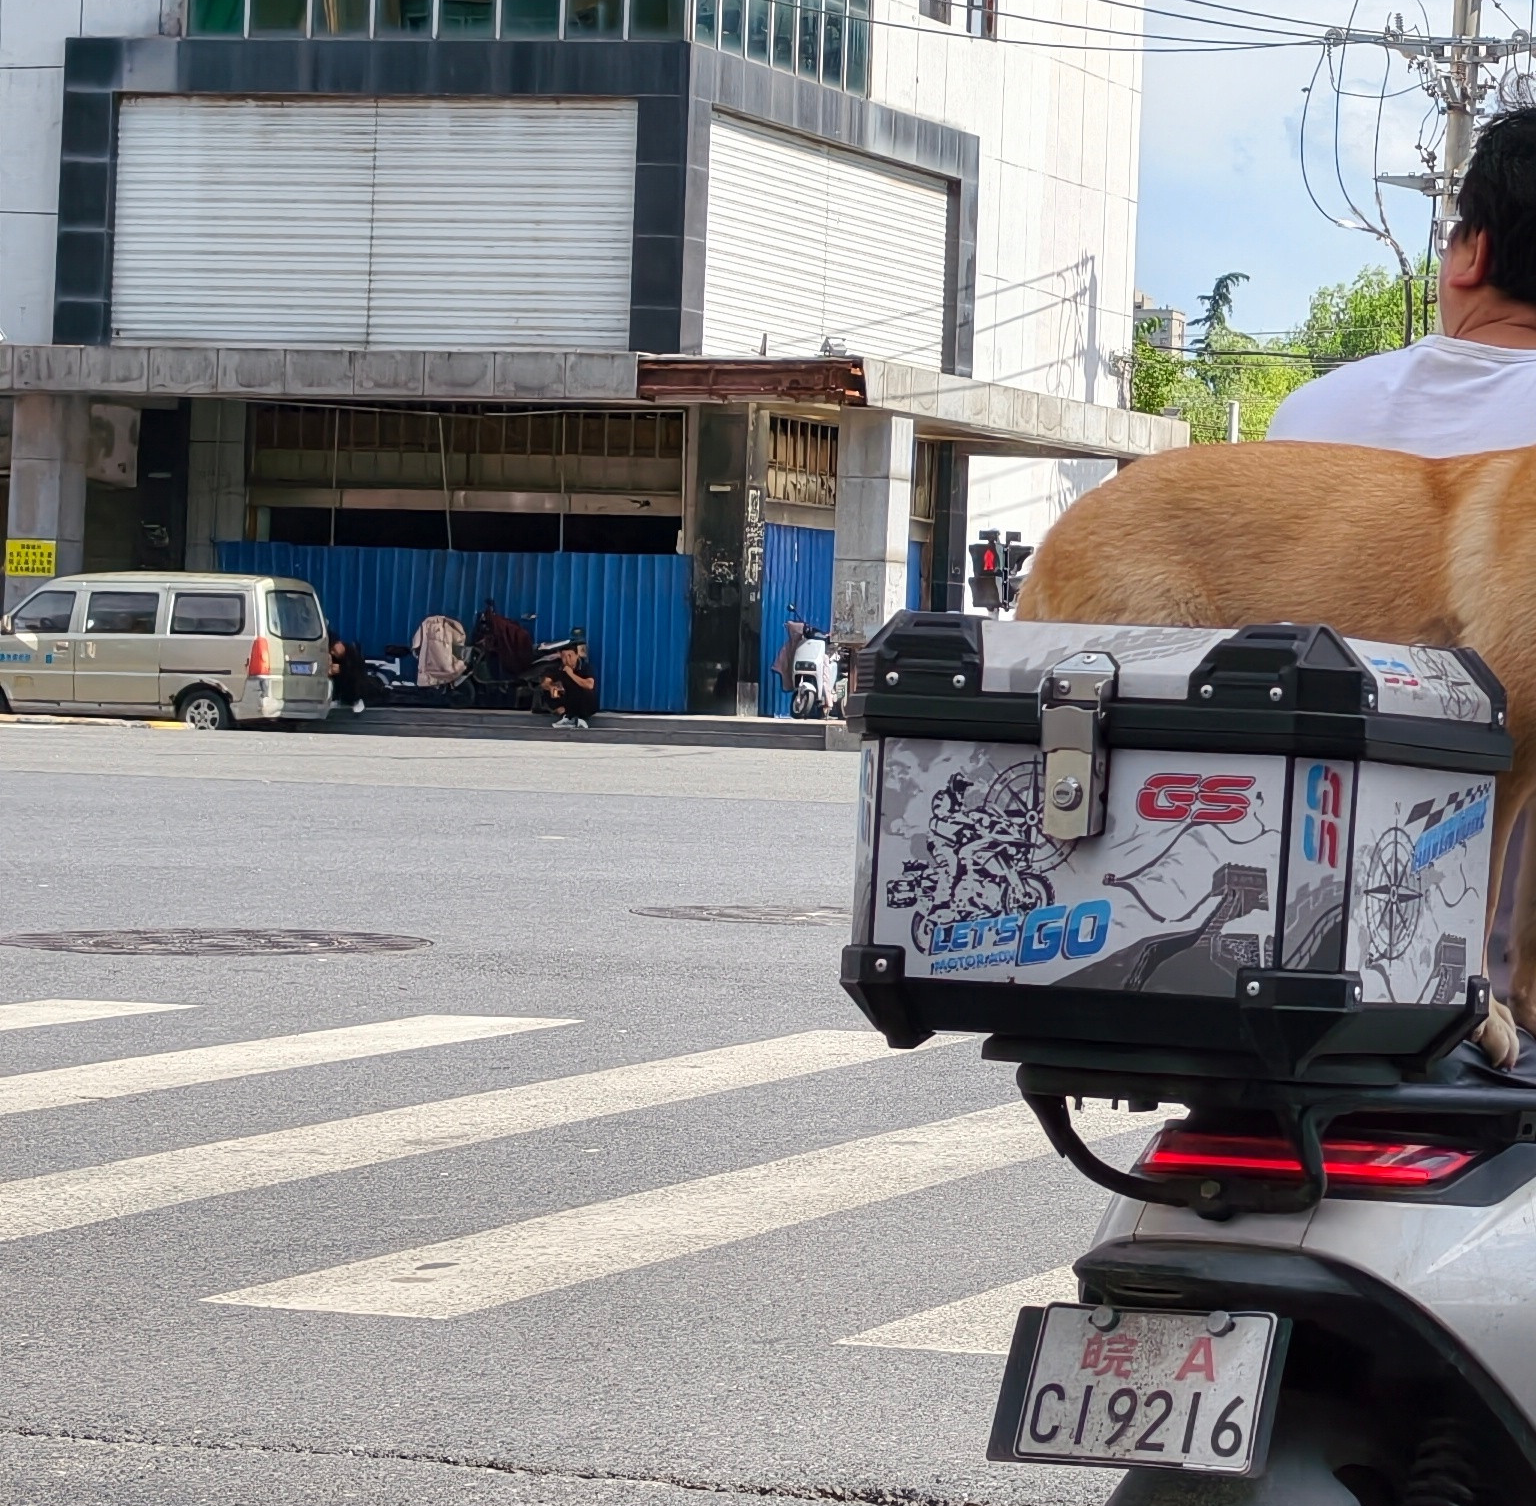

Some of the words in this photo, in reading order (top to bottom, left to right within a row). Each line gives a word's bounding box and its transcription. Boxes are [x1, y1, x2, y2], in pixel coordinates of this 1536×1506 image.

[1135, 772, 1257, 825] GS
[930, 914, 1019, 955] LET'S
[1016, 898, 1112, 967] GO
[1080, 1331, 1139, 1380] 皖
[1174, 1336, 1216, 1383] A
[1028, 1381, 1246, 1458] C19216
